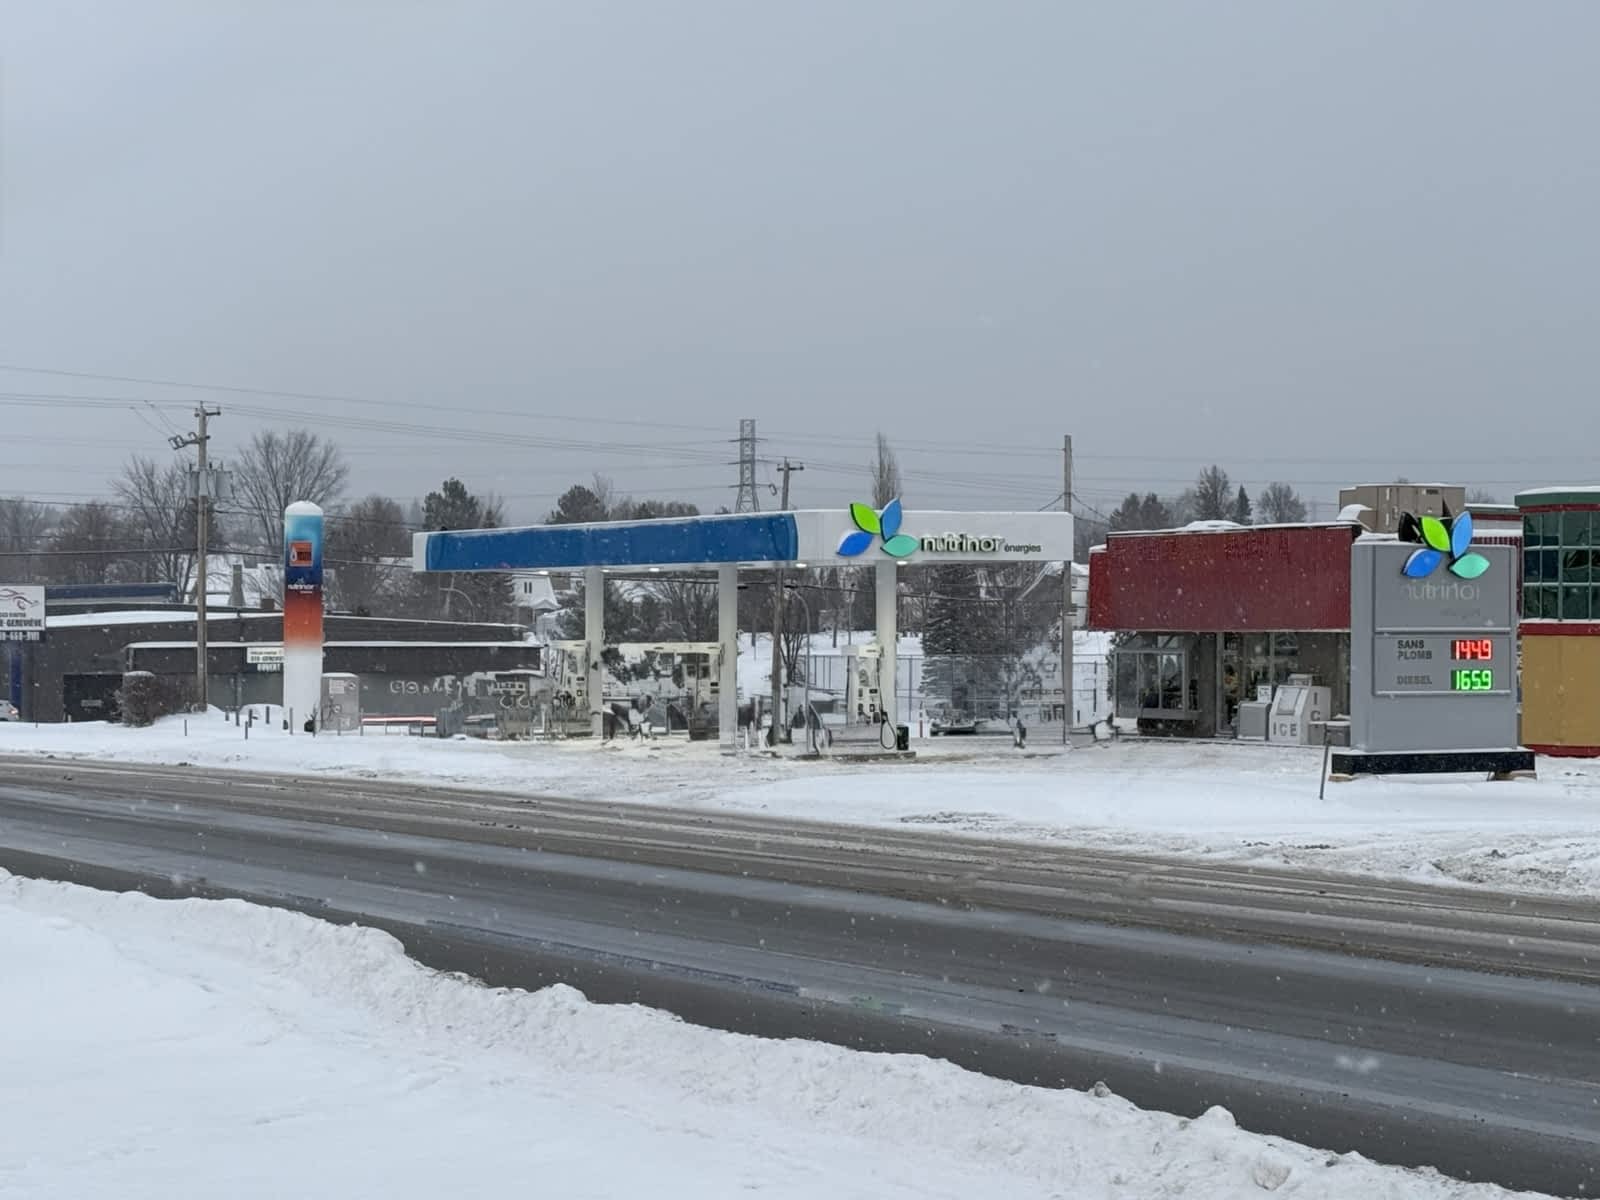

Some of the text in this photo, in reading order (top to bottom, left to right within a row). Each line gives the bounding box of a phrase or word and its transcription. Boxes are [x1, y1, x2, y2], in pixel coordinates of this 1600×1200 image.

[920, 532, 1004, 553] nutrinor
[1397, 639, 1424, 649] SANS
[1397, 650, 1432, 660] PLOMB
[1397, 675, 1432, 685] DIESEL
[1273, 721, 1297, 737] ICE
